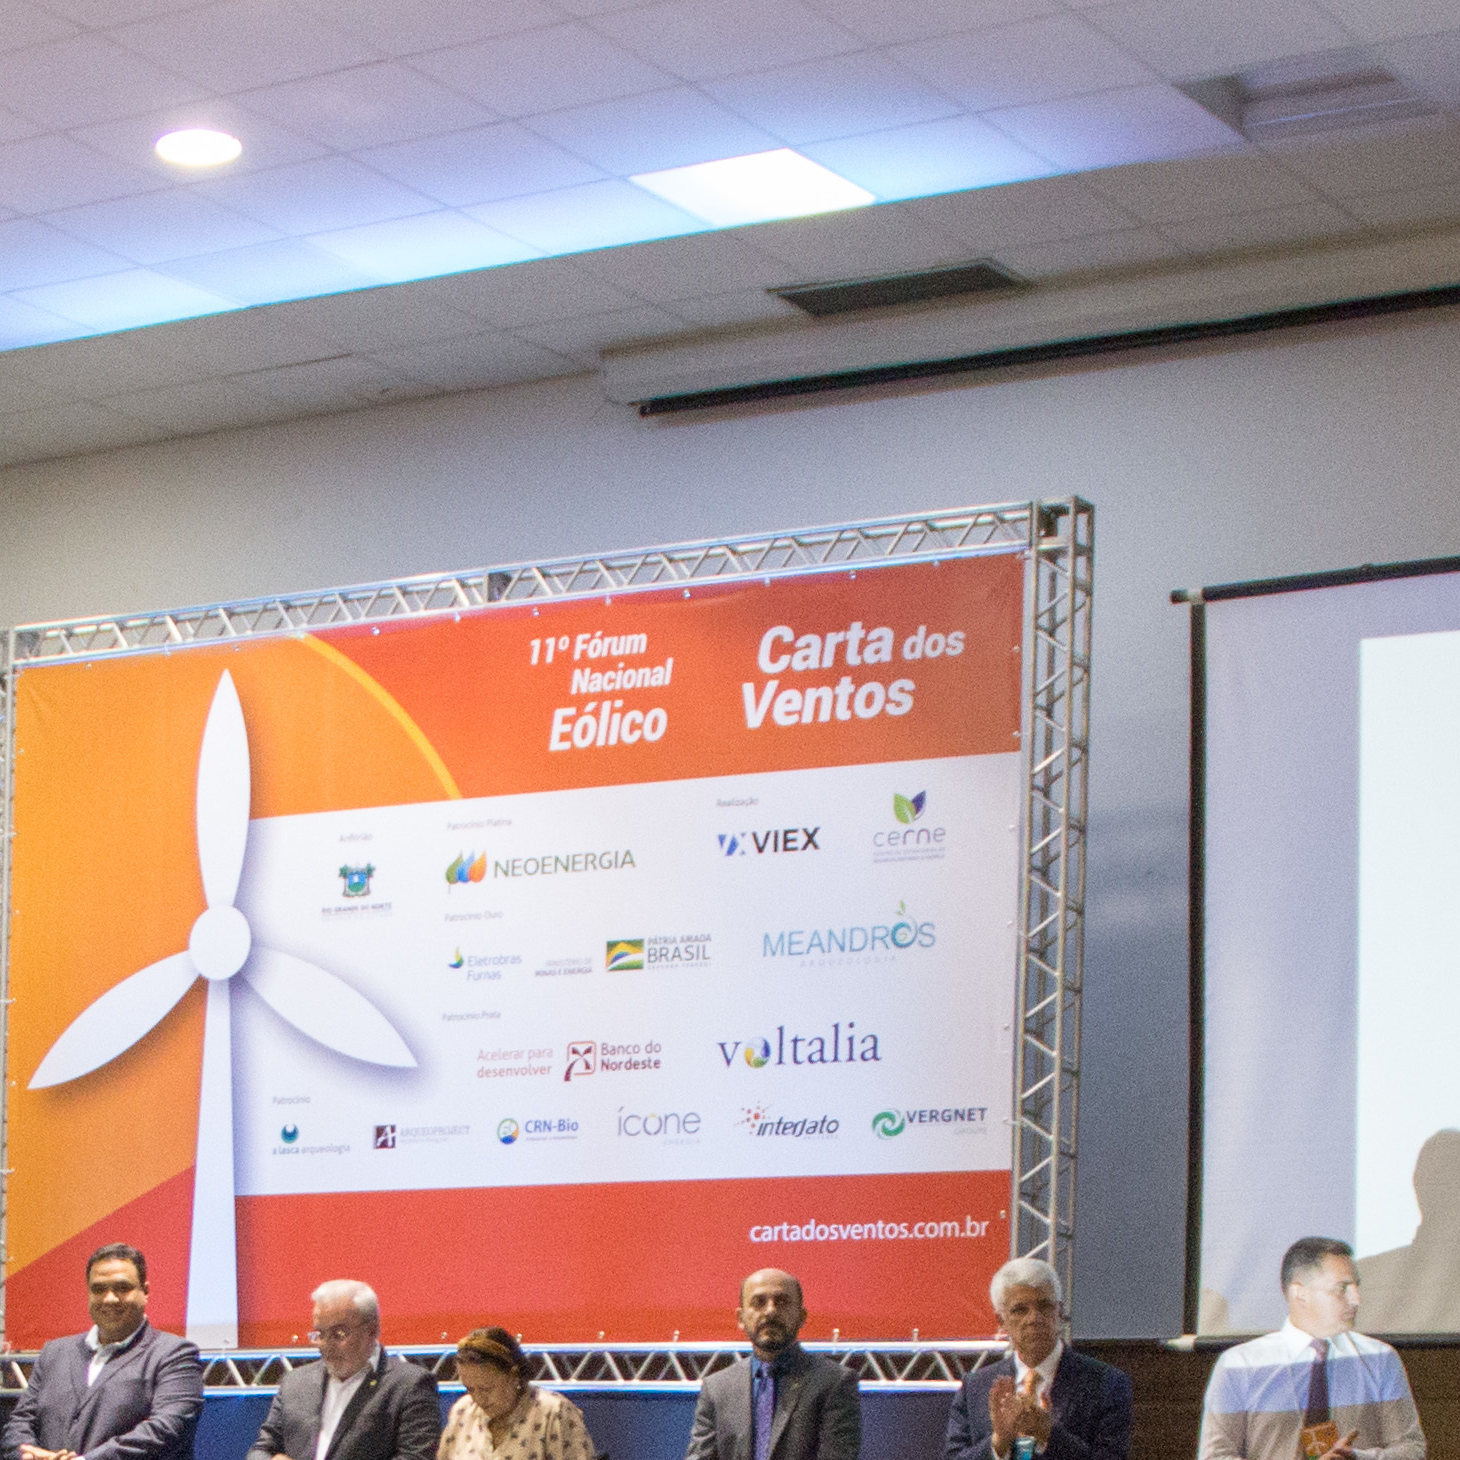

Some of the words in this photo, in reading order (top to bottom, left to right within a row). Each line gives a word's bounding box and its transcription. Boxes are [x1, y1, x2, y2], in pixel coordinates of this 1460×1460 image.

[529, 636, 569, 665] 11º
[573, 630, 648, 661] Fórum
[757, 621, 893, 674] Carta
[901, 625, 966, 661] dos
[570, 658, 673, 695] Nacional
[741, 676, 916, 729] Ventos
[549, 700, 668, 751] Eólico
[752, 826, 821, 854] VIEX
[873, 827, 946, 847] cerne
[494, 849, 636, 879] NEOENERGIA
[762, 920, 937, 957] MEANDROS
[467, 954, 522, 967] Eletrobras
[647, 944, 711, 963] BRASIL
[466, 970, 502, 981] Furnas
[477, 1049, 525, 1061] Acelerar
[527, 1047, 554, 1061] para
[600, 1042, 640, 1056] Banco
[644, 1039, 662, 1054] do
[717, 1021, 883, 1068] voltalia
[477, 1063, 552, 1078] desenvolver
[600, 1057, 662, 1071] Nordeste
[524, 1118, 580, 1134] CRN-Bio
[617, 1105, 701, 1136] ícone
[907, 1107, 988, 1125] VERGNET
[749, 1215, 990, 1243] cartadosventos.com.br
